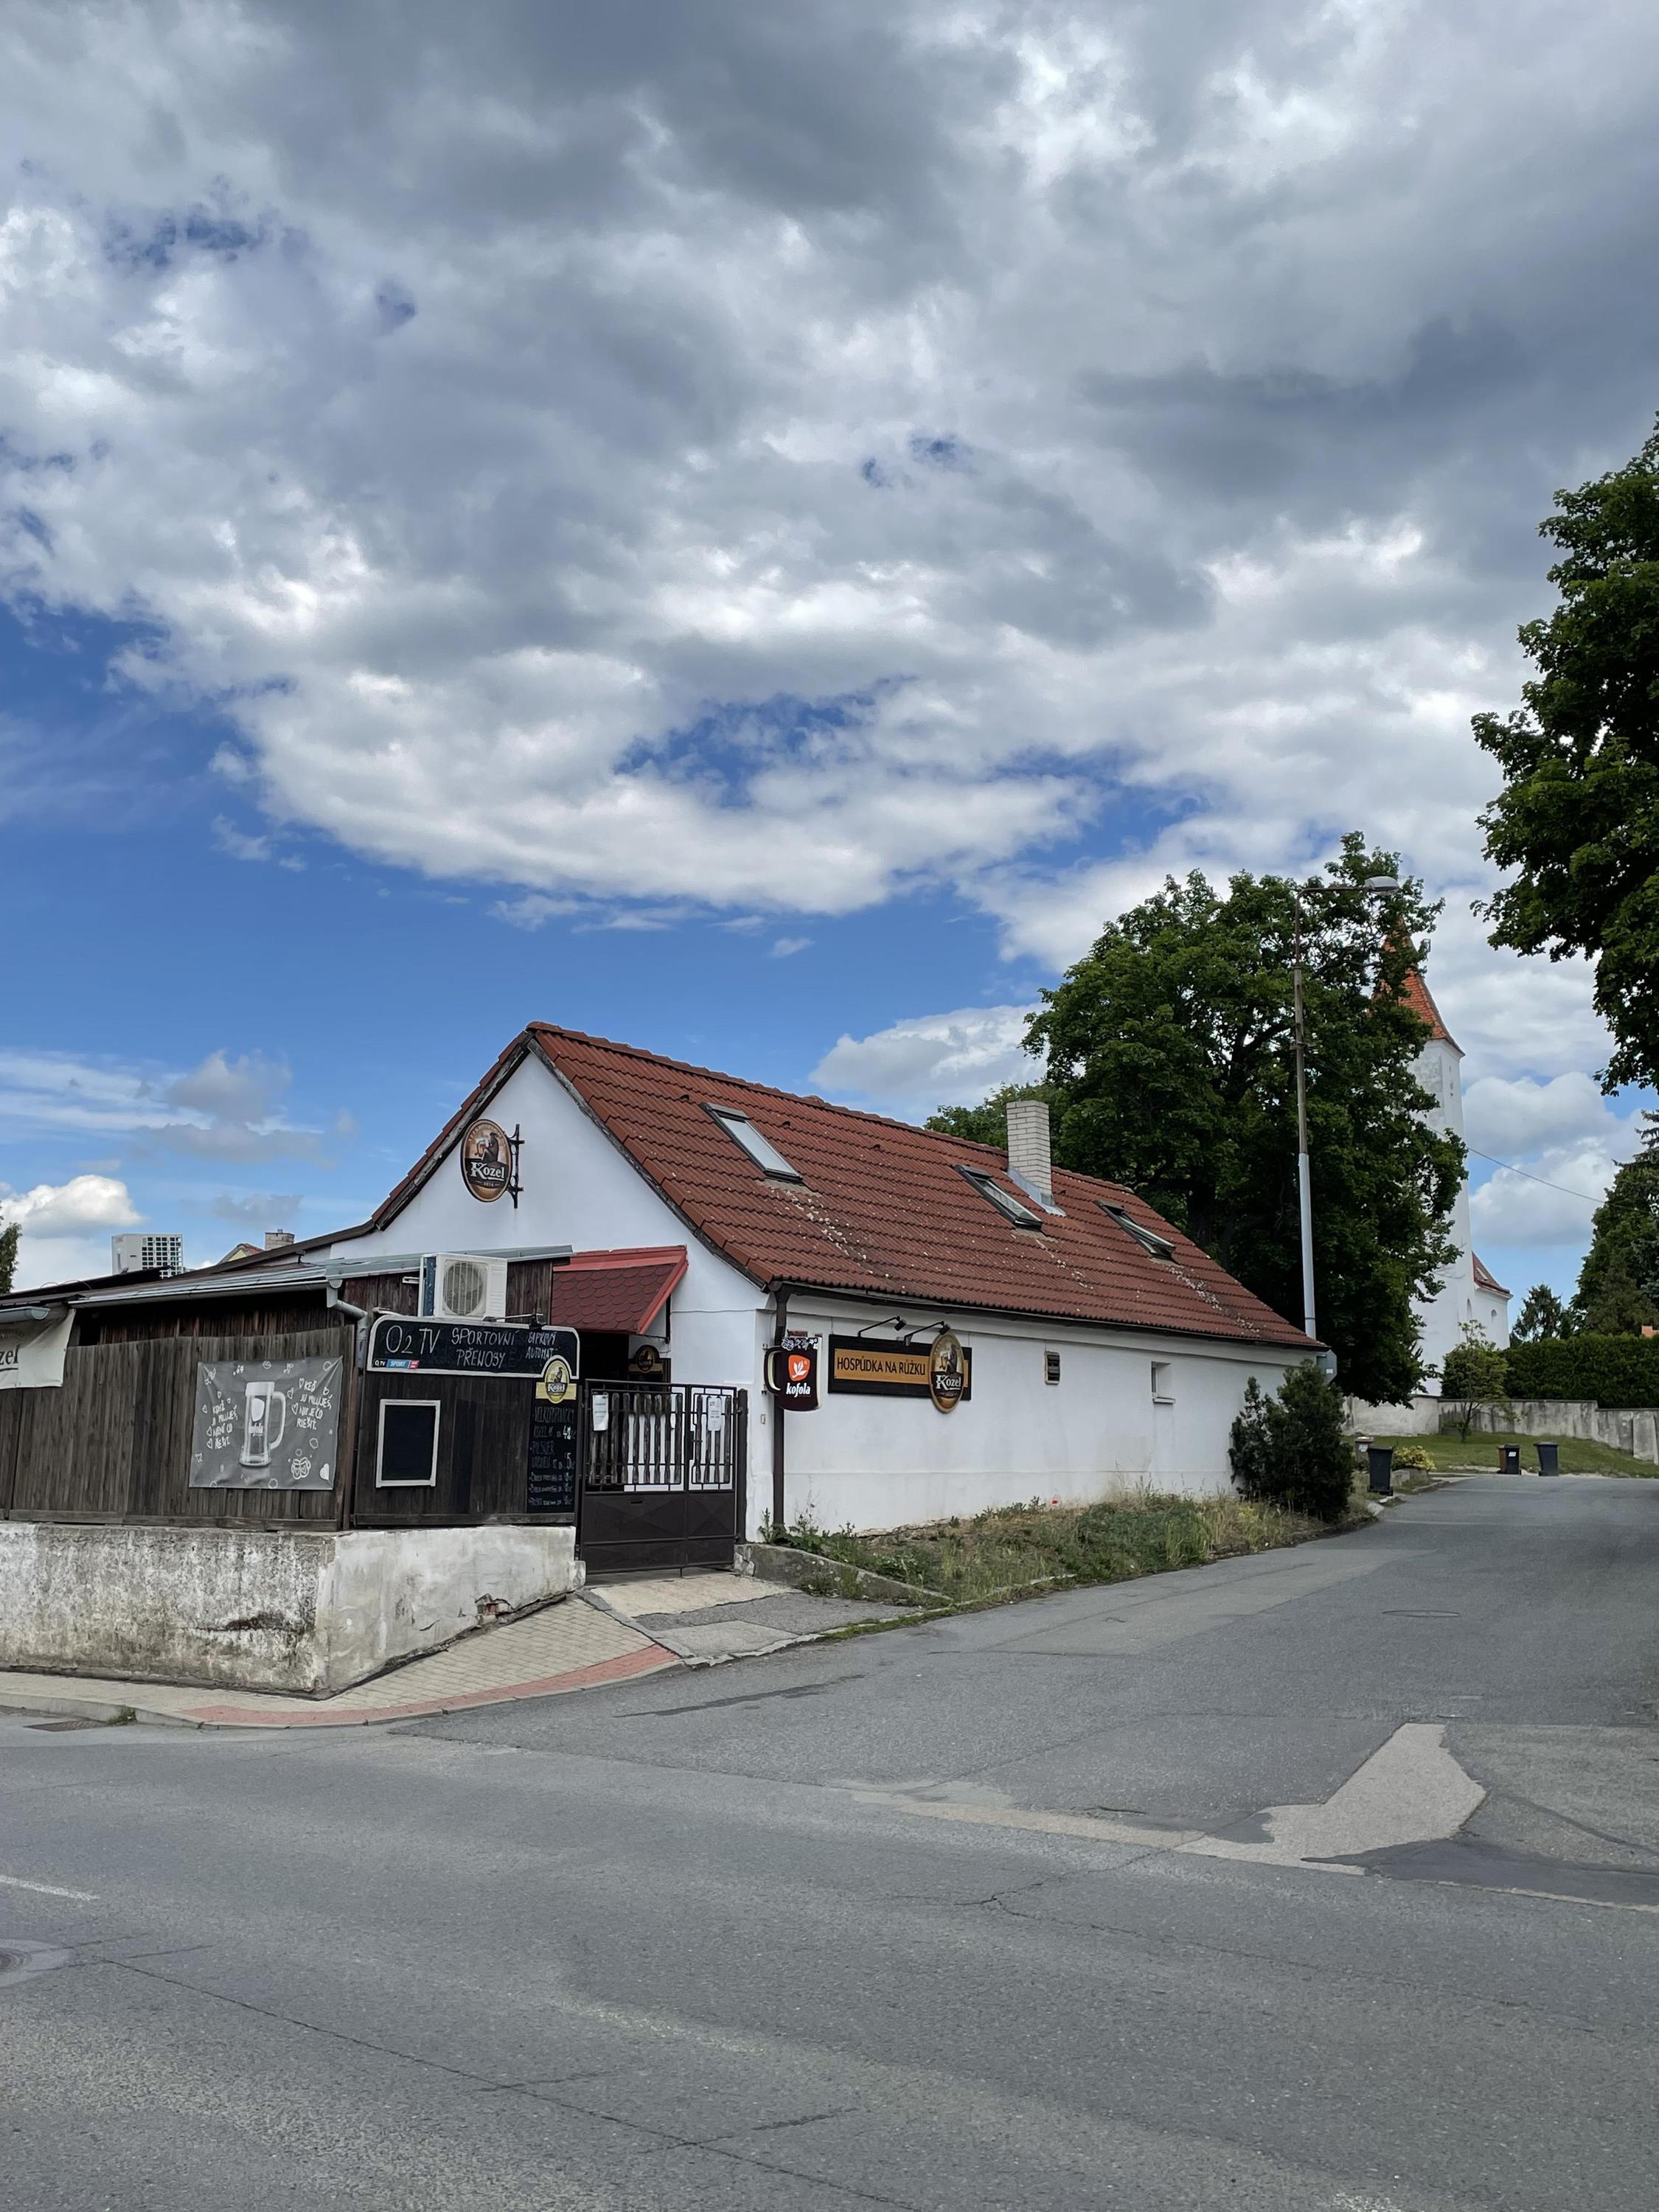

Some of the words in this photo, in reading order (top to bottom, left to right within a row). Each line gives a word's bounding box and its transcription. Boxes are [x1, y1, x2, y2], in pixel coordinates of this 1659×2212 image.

[470, 1161, 505, 1180] Kozel
[419, 1328, 441, 1354] TV
[451, 1327, 520, 1346] SPORTOVNÍ
[456, 1347, 506, 1368] PŘENOSY
[525, 1346, 554, 1361] AUTOMAT
[837, 1355, 883, 1373] HOSPŮDKA
[885, 1360, 897, 1374] NA
[899, 1359, 926, 1376] RŮŽKU
[548, 1383, 566, 1392] Kozel
[786, 1382, 811, 1398] kofola
[935, 1374, 961, 1391] Kozel
